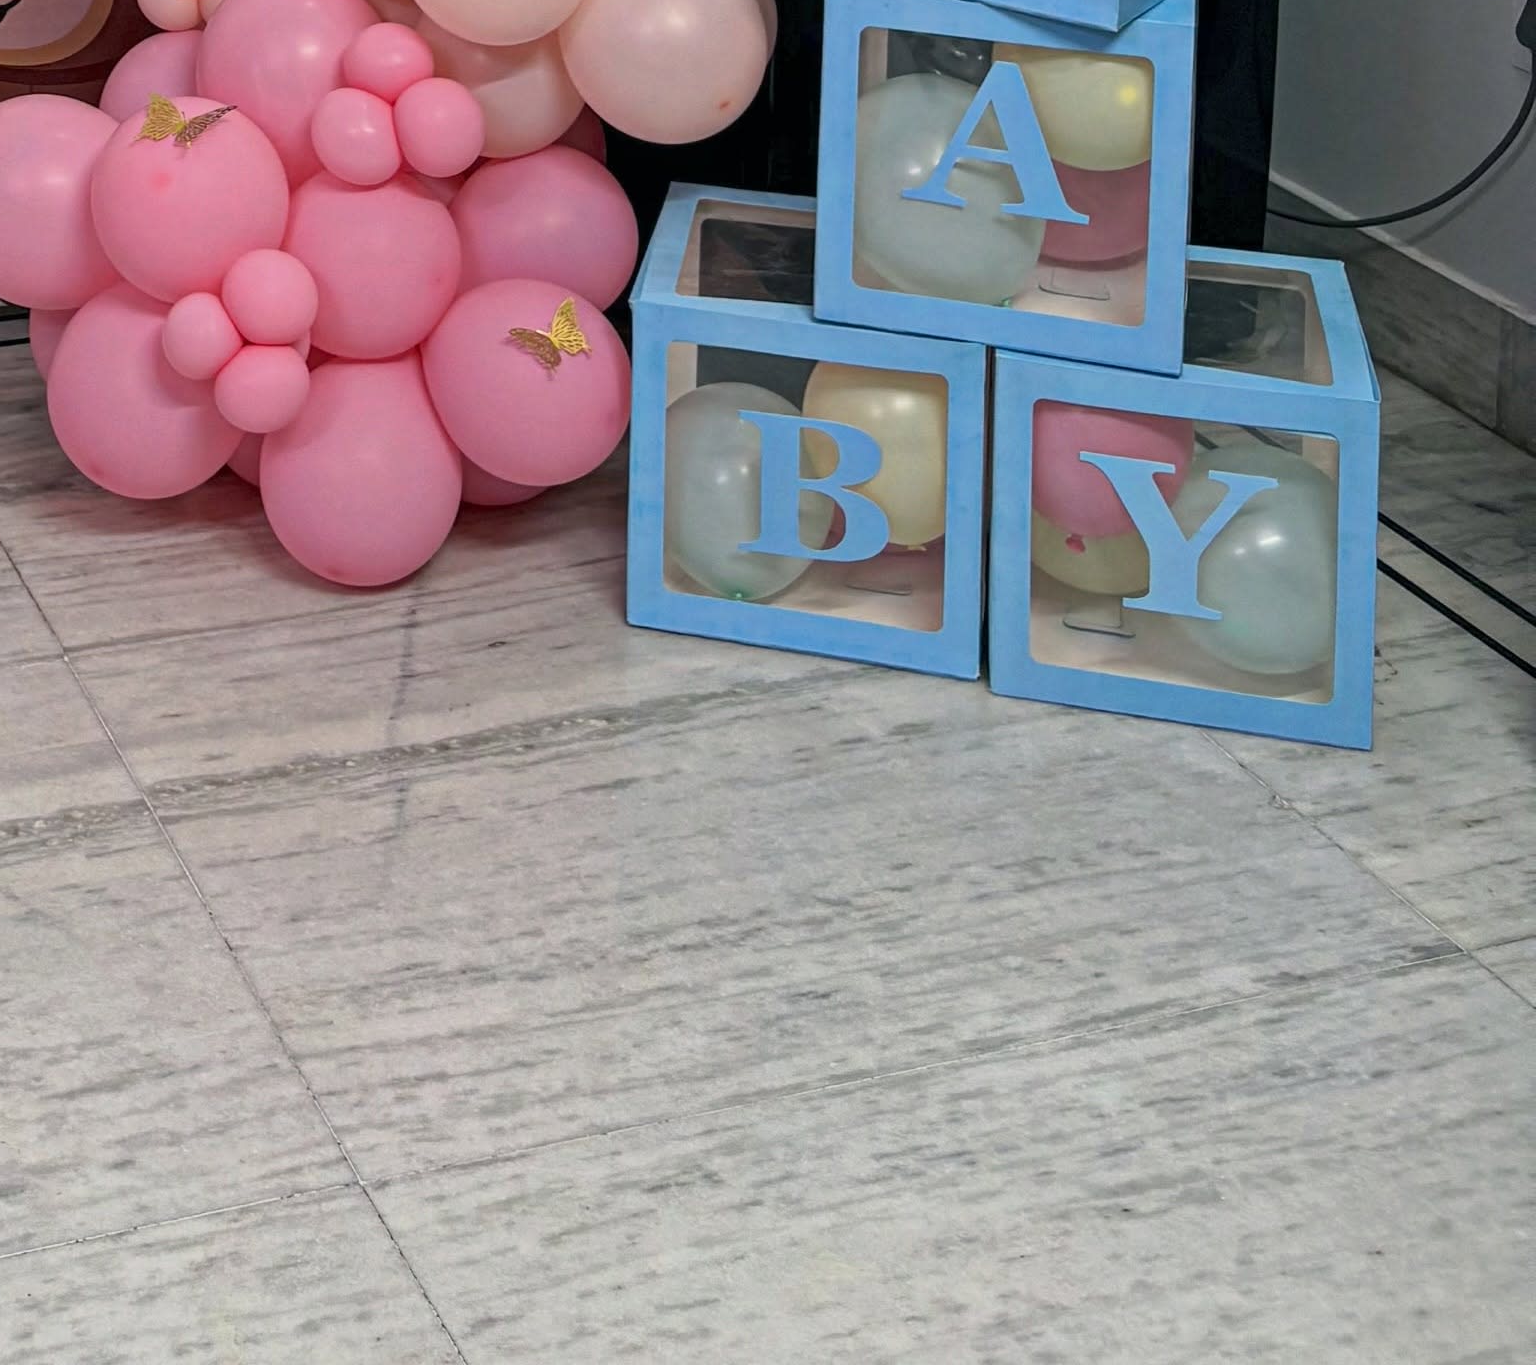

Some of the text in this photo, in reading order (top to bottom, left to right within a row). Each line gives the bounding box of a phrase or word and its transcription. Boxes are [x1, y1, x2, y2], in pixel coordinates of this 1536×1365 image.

[901, 61, 1090, 225] A
[737, 410, 890, 563] B
[1079, 451, 1279, 620] Y
